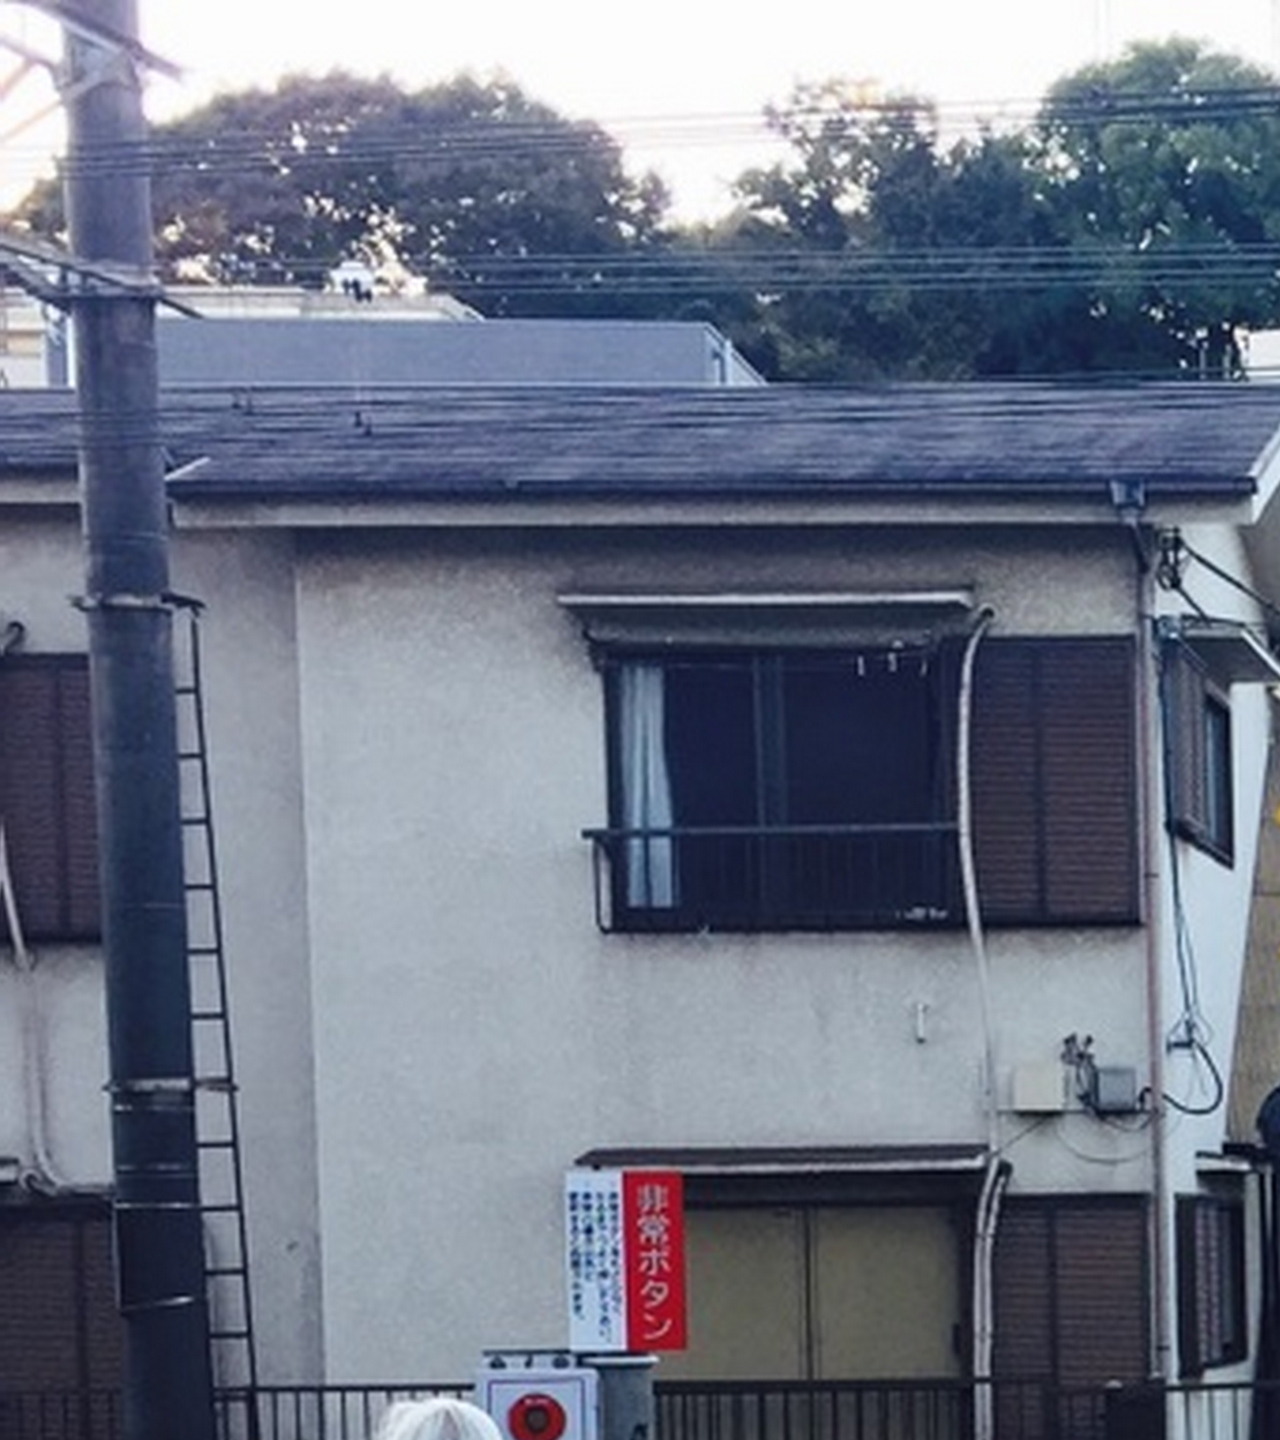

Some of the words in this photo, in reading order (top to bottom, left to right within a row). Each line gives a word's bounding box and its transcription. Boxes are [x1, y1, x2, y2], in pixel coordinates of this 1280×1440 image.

[637, 1184, 673, 1341] 非常ボタン
